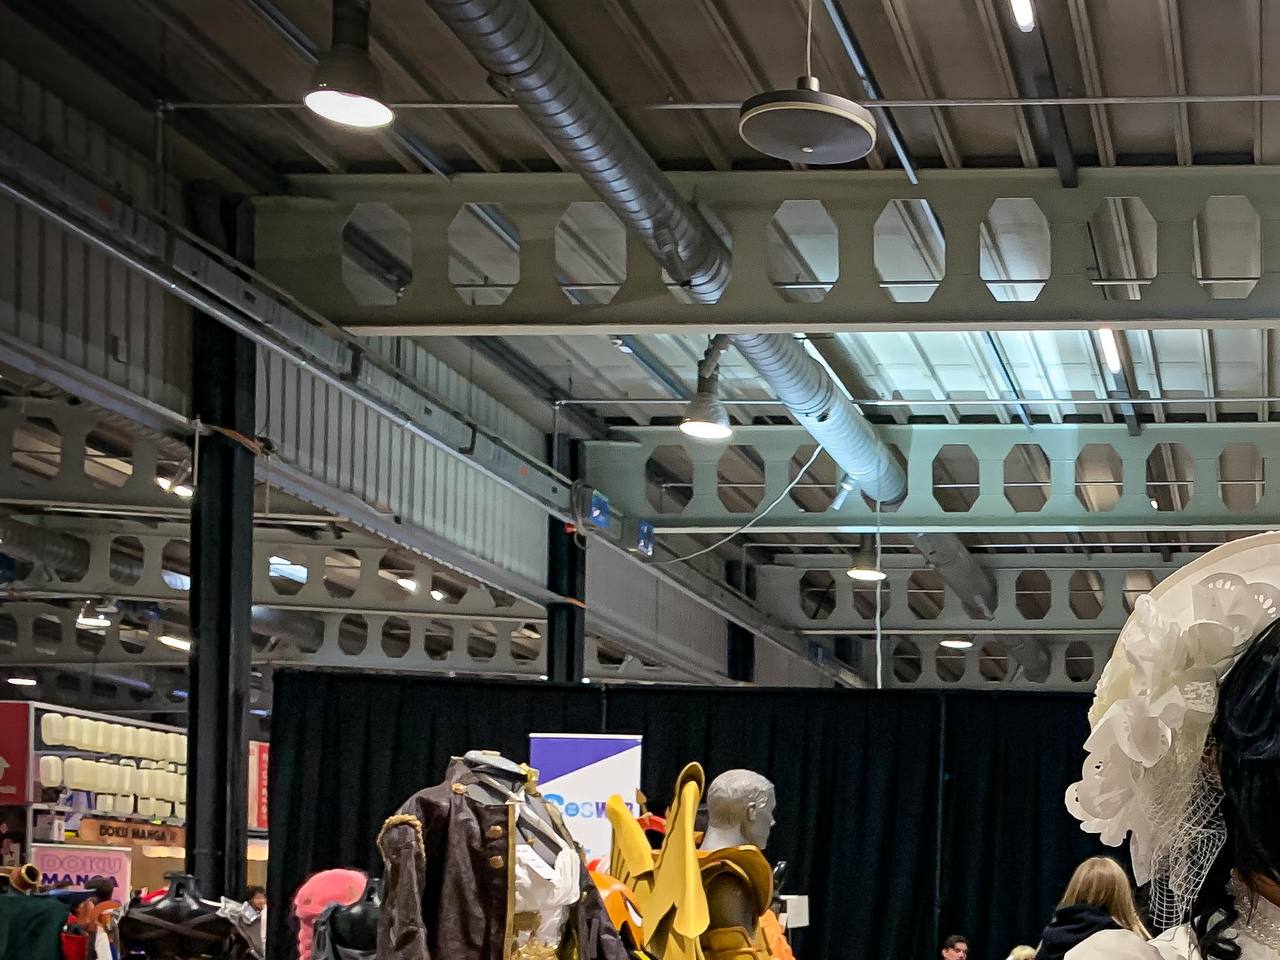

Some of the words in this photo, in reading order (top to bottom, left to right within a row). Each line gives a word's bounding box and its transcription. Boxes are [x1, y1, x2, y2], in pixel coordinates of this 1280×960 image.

[100, 824, 128, 838] DOKU
[131, 827, 166, 842] MANGA
[41, 854, 122, 873] DOKU
[42, 872, 118, 888] MANA
